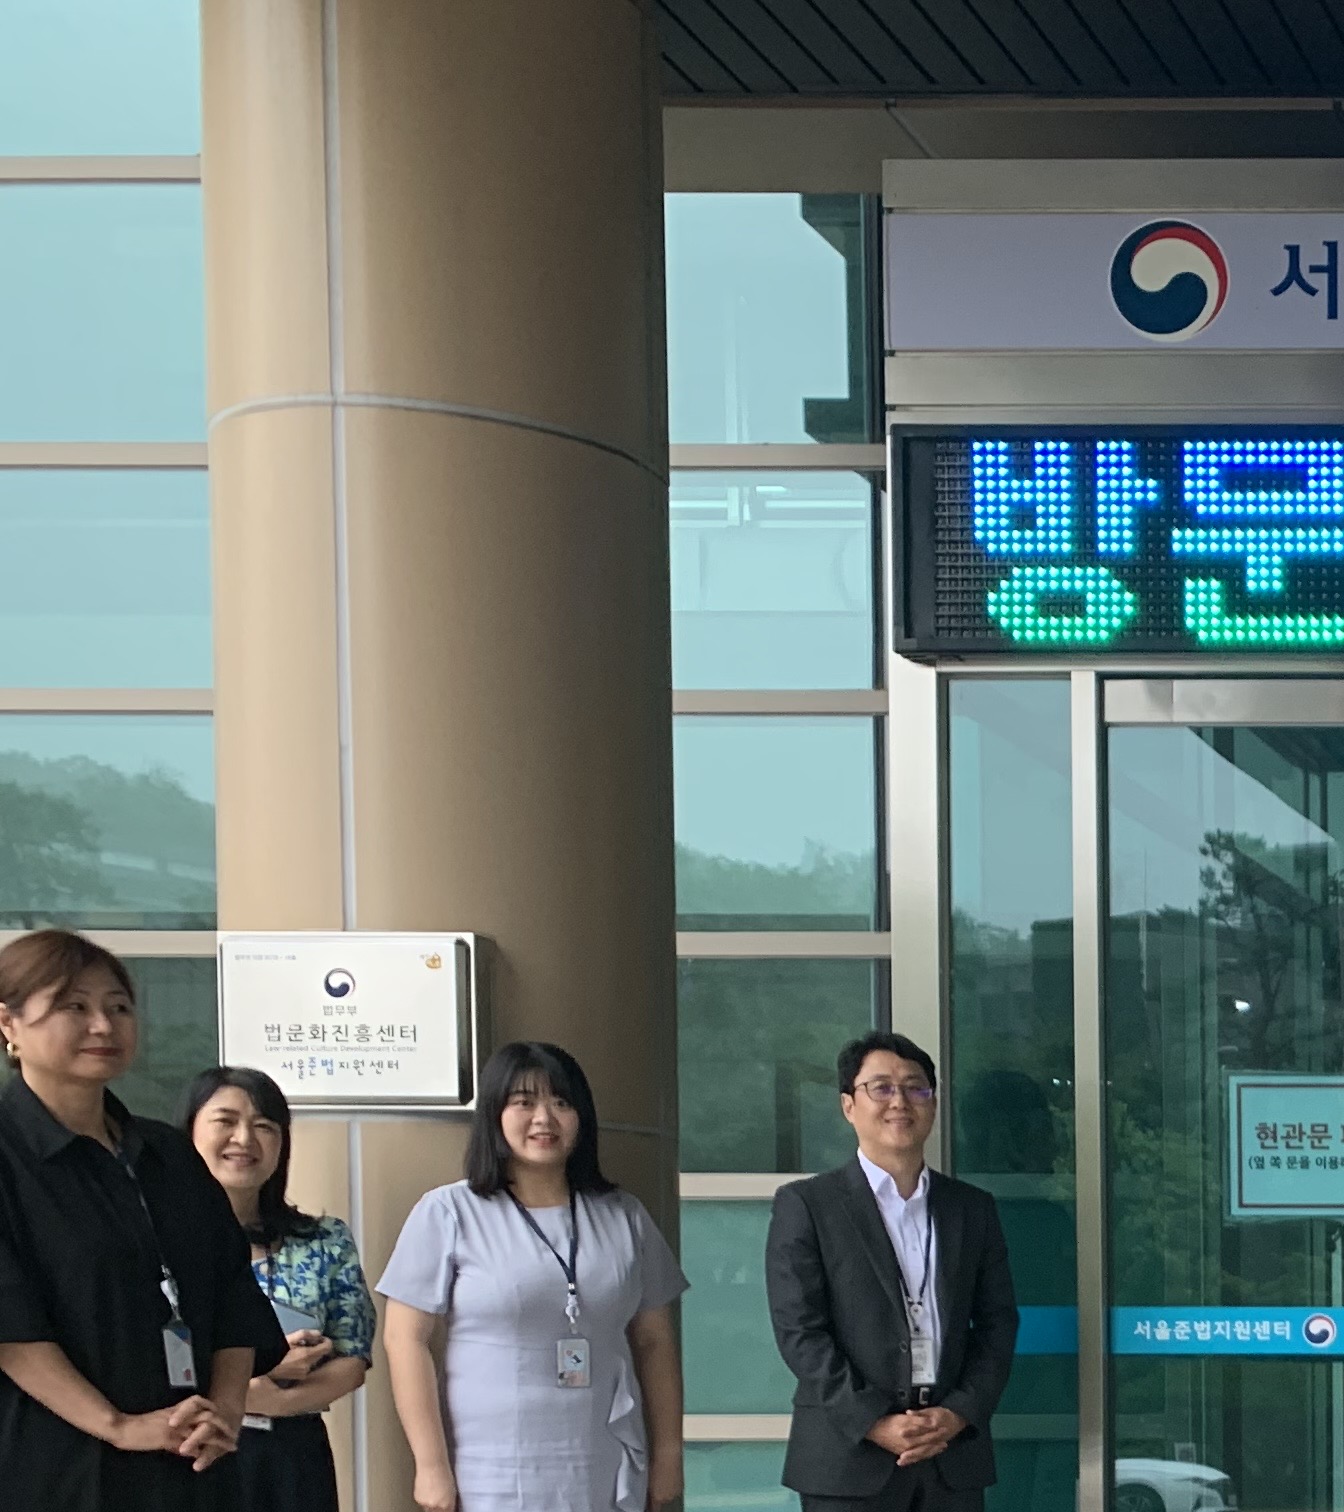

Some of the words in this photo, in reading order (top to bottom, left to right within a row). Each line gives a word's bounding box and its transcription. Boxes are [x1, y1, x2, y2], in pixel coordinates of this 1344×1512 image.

[322, 1005, 357, 1017] 법무부
[264, 1023, 418, 1043] 법문화진흥센터
[281, 1056, 399, 1080] 서울준법지원센터
[1255, 1122, 1333, 1150] 현관문
[1286, 1156, 1310, 1169] 문을
[1134, 1320, 1291, 1341] 서울준법지원센터
